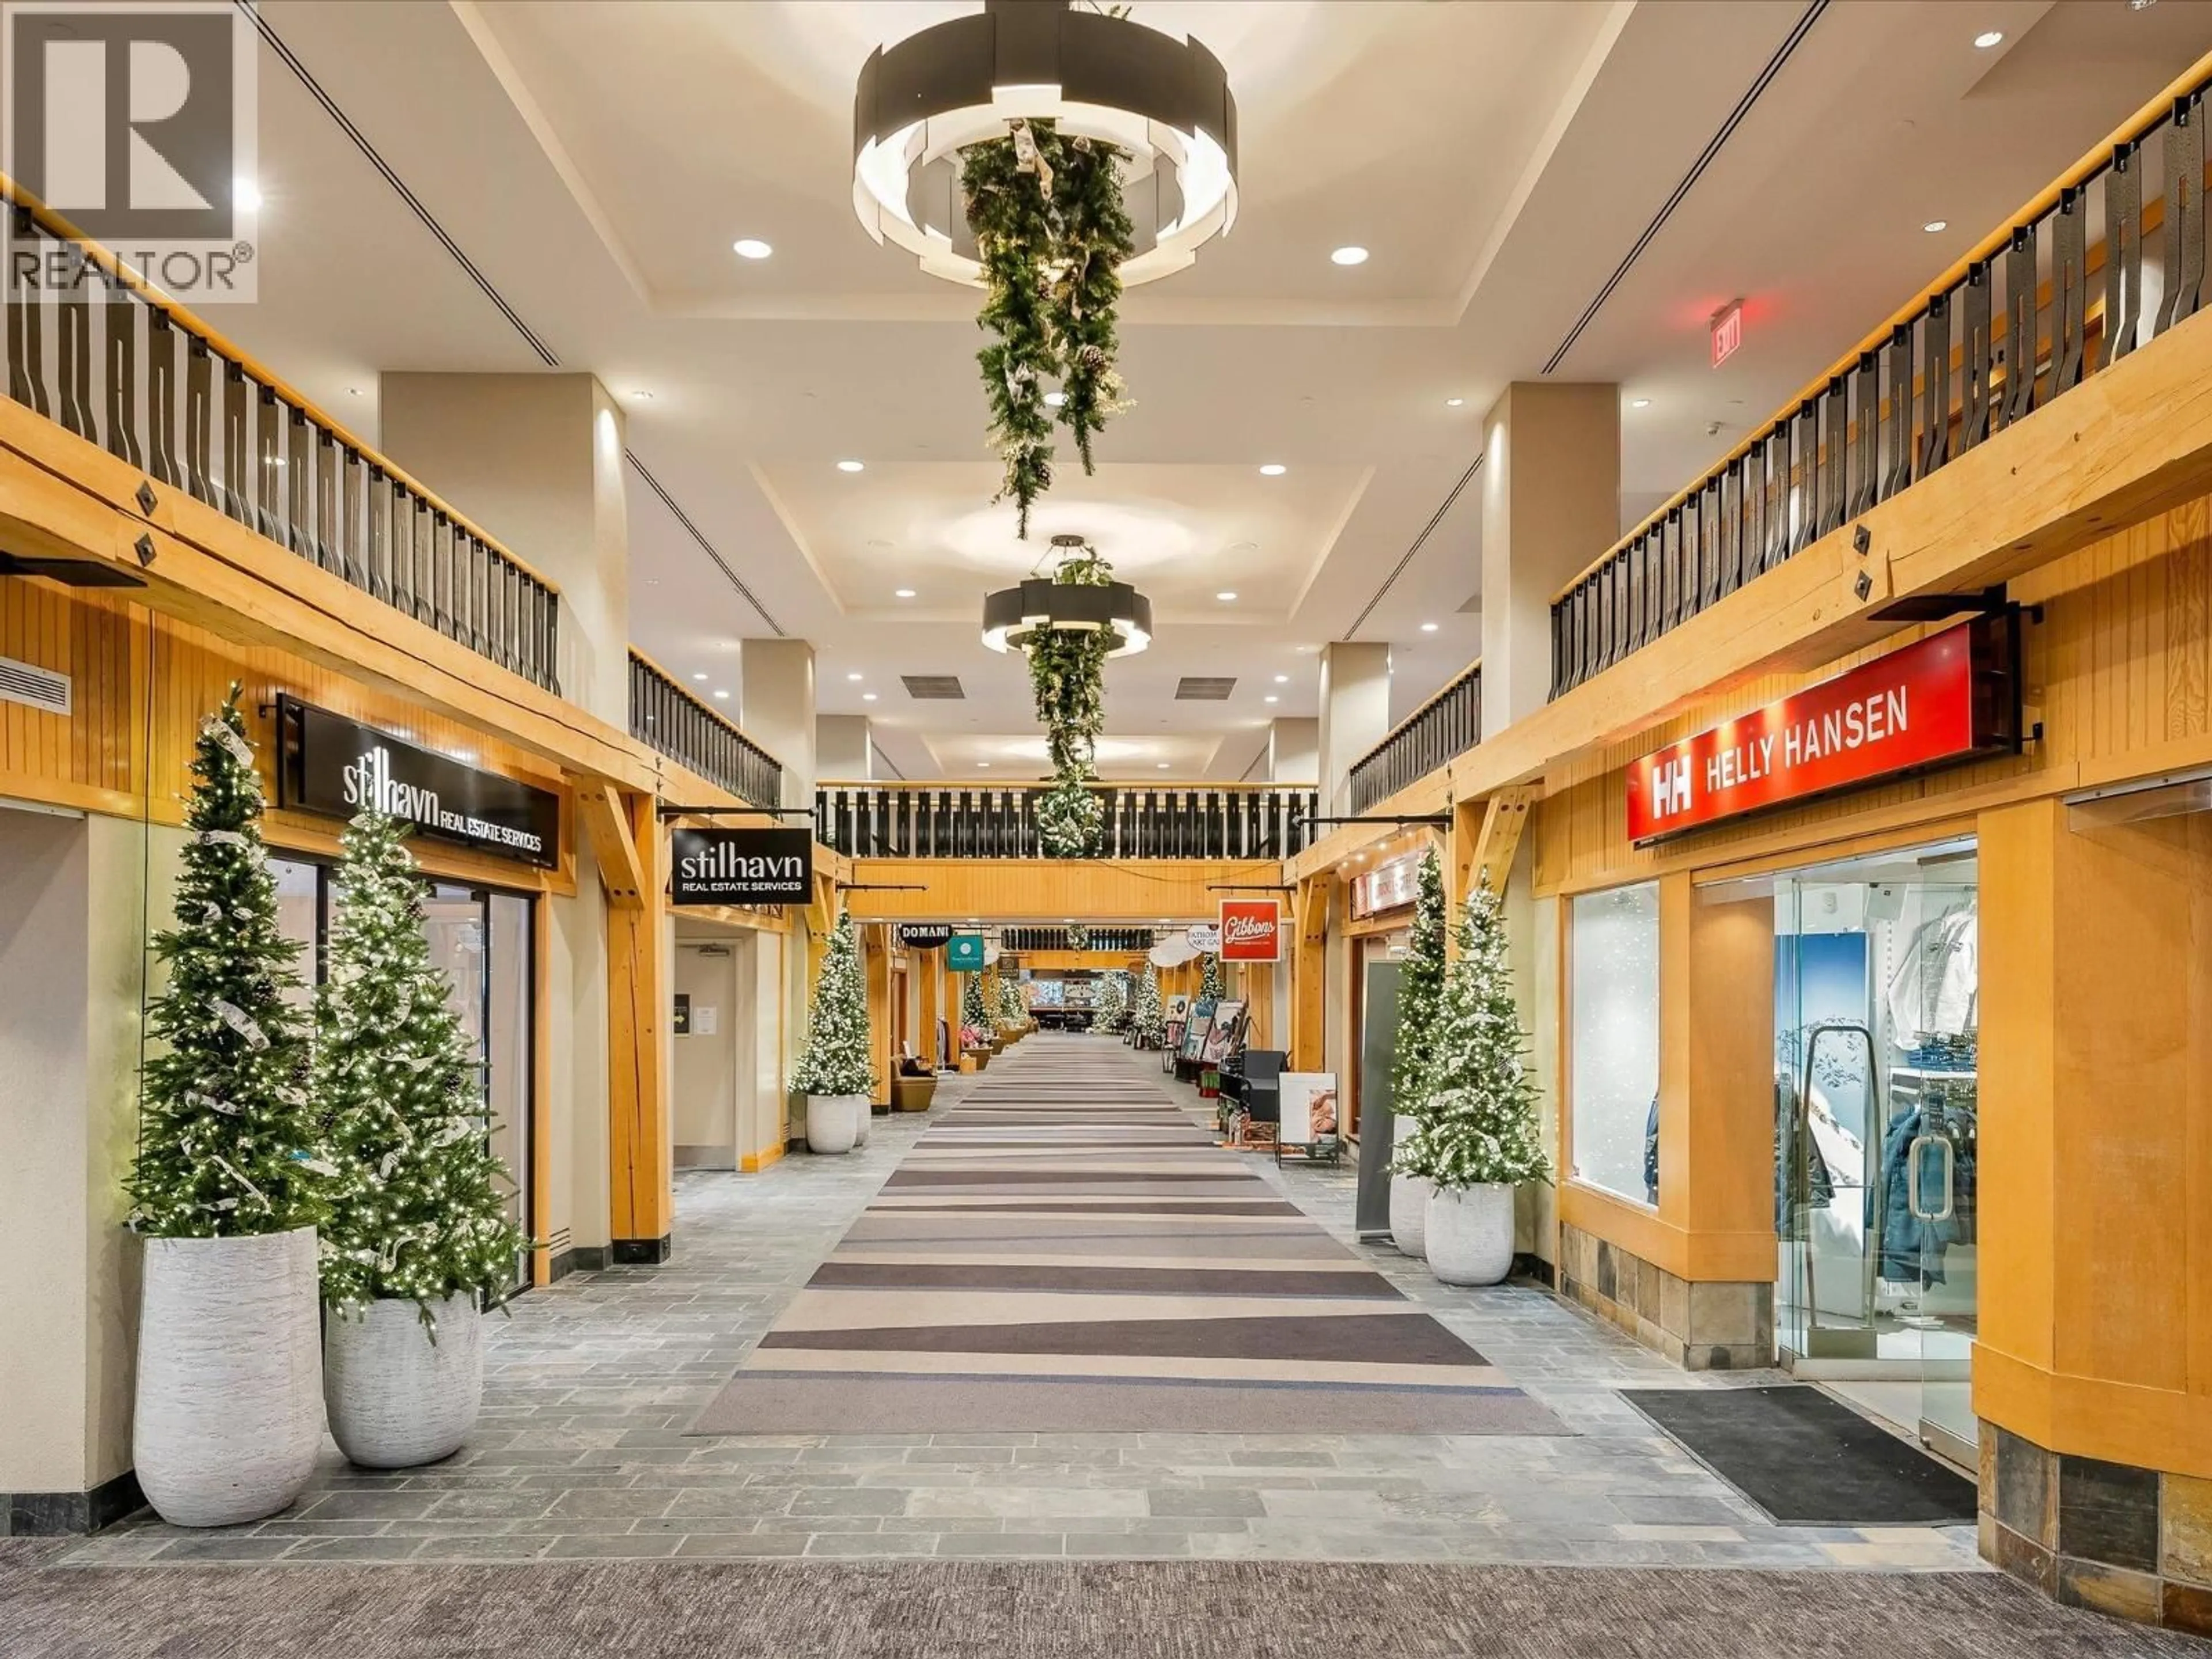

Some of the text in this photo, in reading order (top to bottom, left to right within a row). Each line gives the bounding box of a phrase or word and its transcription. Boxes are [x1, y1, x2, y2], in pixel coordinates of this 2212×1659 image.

[1706, 734, 1774, 794] HELLY
[1785, 685, 1907, 769] HANSEN
[343, 747, 542, 853] stilhavn REAL ESTATE SERVICES
[680, 841, 803, 878] stilhavn
[682, 882, 802, 892] REAL ESTATE SERVICES
[902, 926, 949, 938] DOMANI
[1225, 916, 1275, 943] Gibbons
